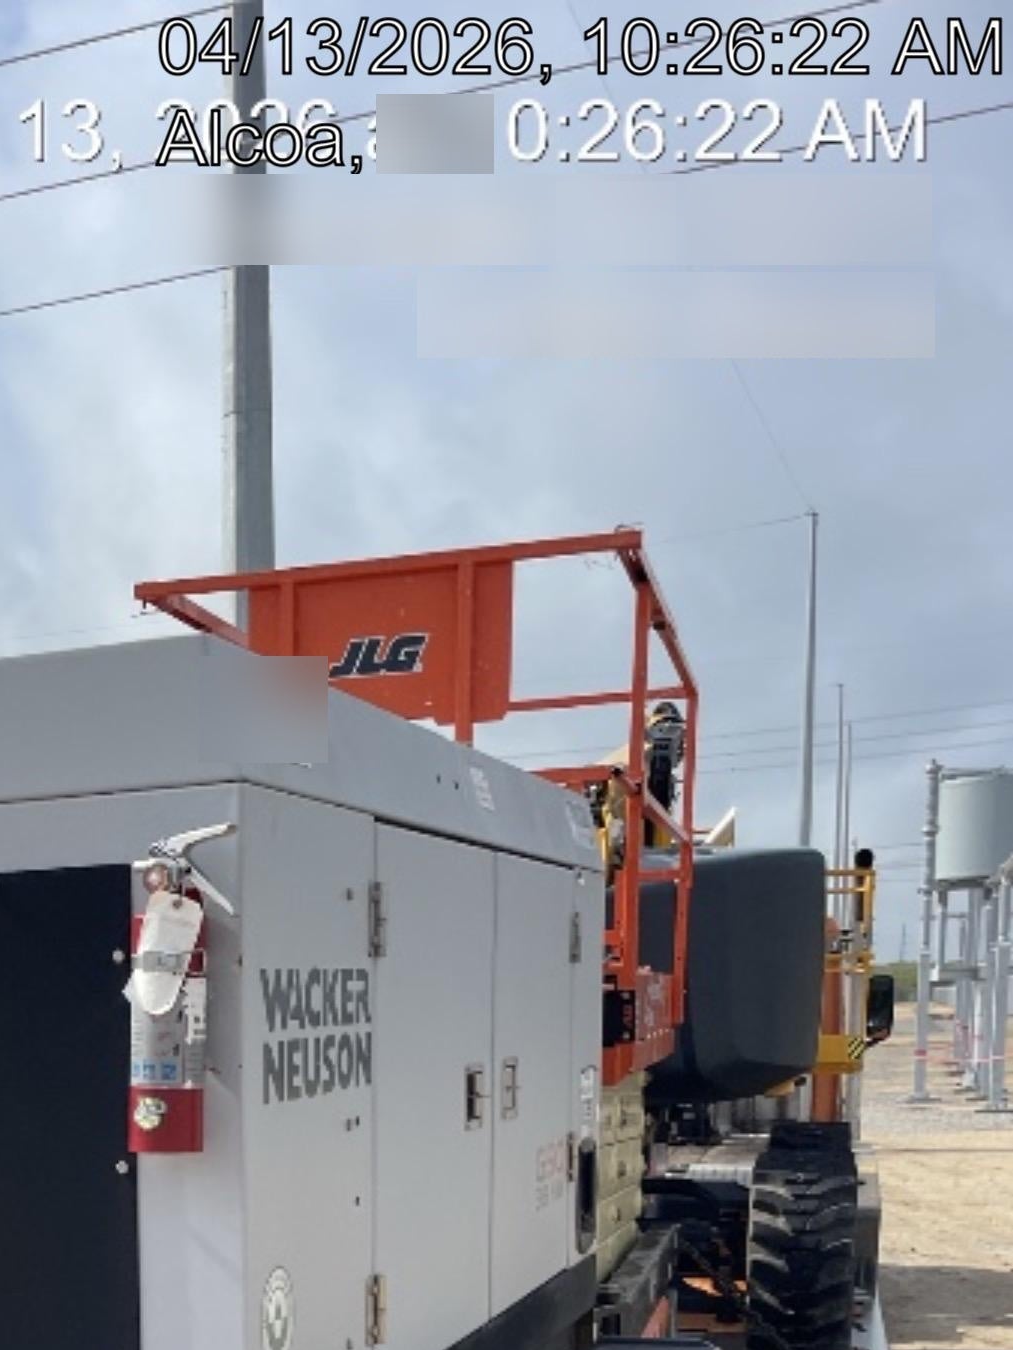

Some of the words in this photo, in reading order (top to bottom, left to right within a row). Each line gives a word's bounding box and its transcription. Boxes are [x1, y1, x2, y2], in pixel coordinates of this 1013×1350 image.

[328, 632, 430, 681] JLG
[259, 966, 372, 1033] WACKER
[262, 1031, 372, 1105] NEUSON
